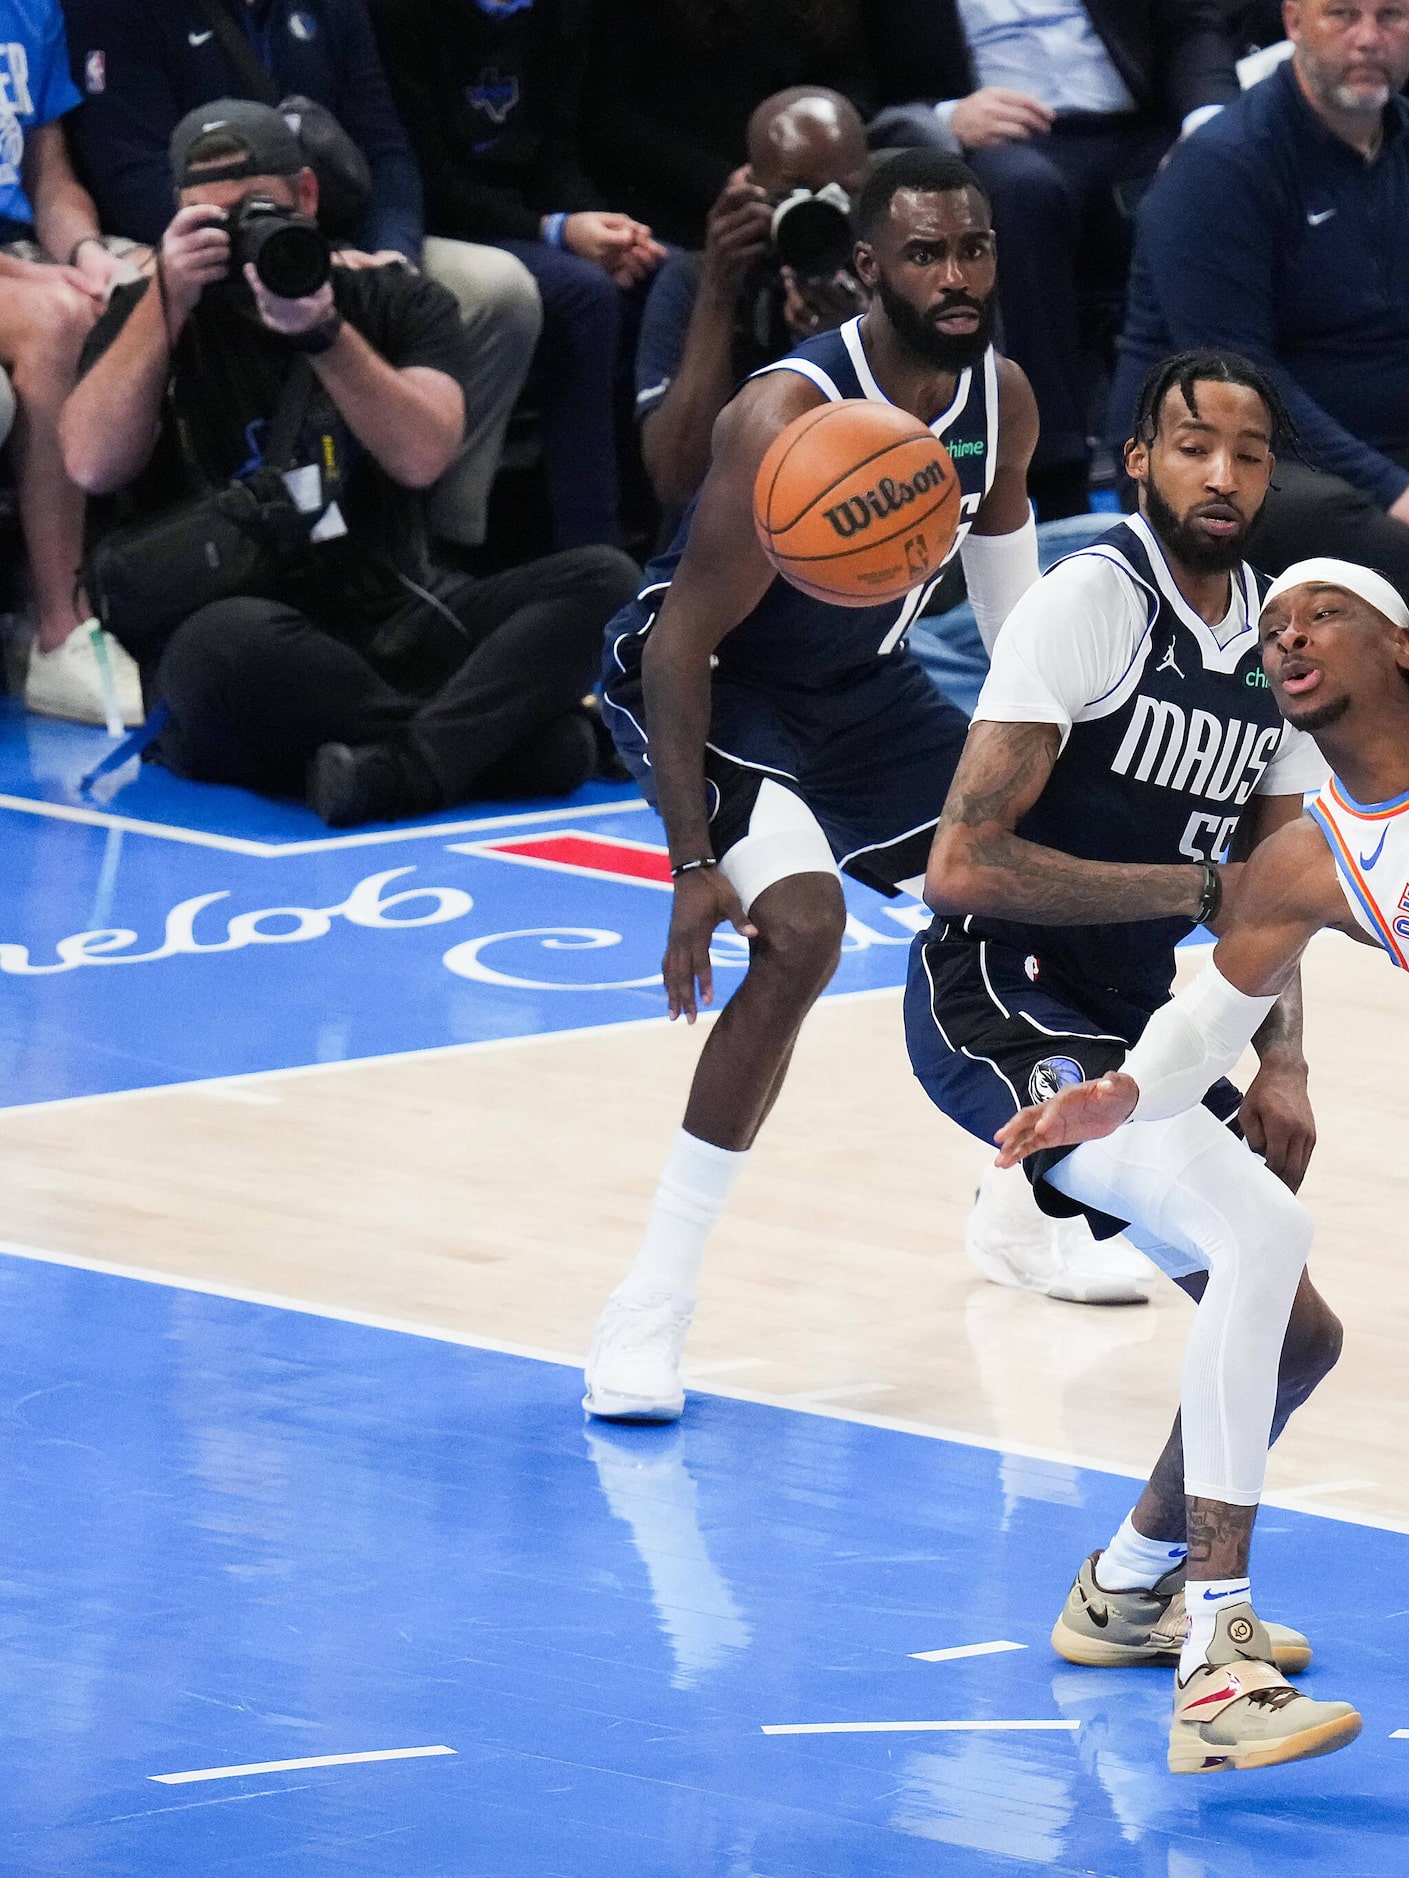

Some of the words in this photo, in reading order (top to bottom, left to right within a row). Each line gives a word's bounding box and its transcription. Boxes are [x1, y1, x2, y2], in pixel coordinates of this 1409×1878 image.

[946, 439, 984, 458] hime
[823, 460, 946, 538] Wilson
[1110, 694, 1282, 806] MAVS
